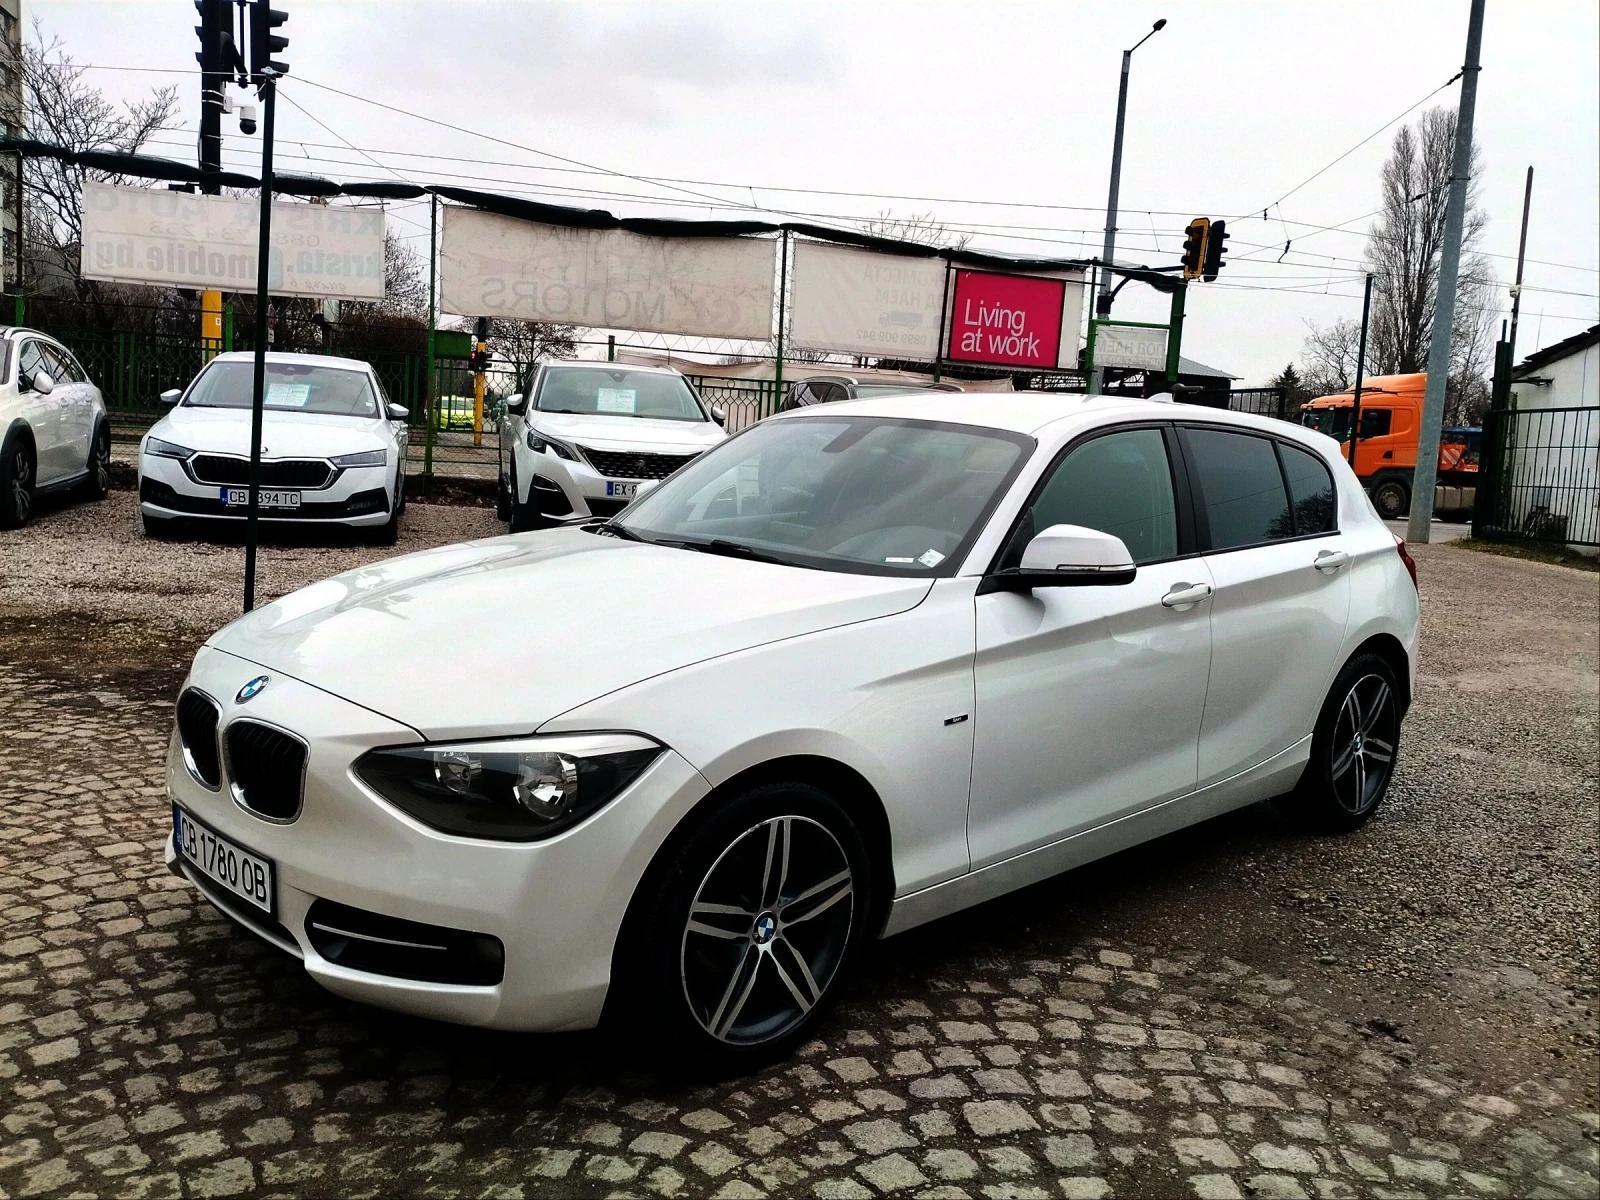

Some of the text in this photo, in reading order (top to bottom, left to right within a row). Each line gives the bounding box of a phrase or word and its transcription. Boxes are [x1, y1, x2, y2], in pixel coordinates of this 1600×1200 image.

[964, 299, 1025, 337] Living
[961, 328, 1041, 358] at work
[229, 491, 247, 503] CB
[257, 492, 279, 504] 394
[281, 493, 298, 505] TC
[182, 816, 197, 860] CB
[200, 833, 238, 887] 1780
